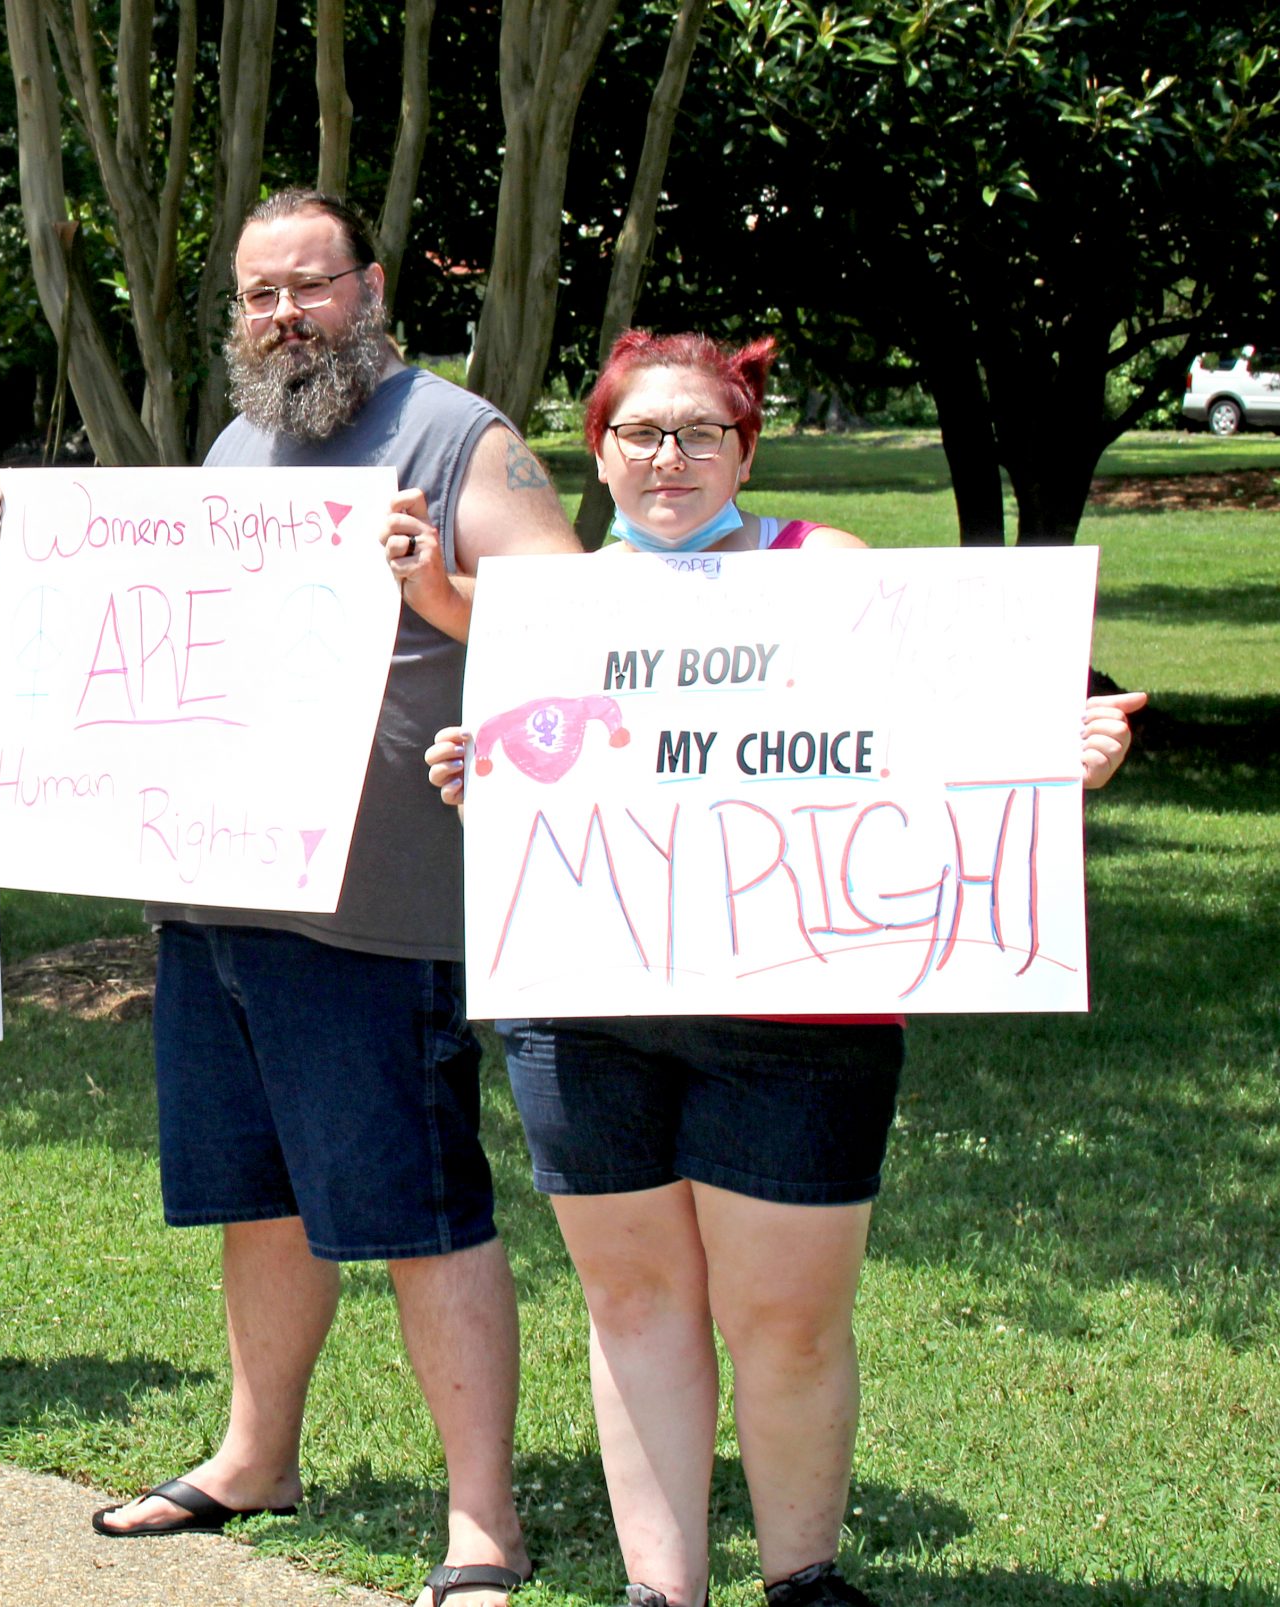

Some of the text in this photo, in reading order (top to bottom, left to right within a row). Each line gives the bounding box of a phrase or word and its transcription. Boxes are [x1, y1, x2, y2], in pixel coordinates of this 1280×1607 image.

[23, 482, 186, 561] Womens
[76, 584, 231, 718] ARE
[604, 649, 664, 690] MY
[656, 731, 718, 774] MY
[490, 779, 1081, 999] MY RIGHT
